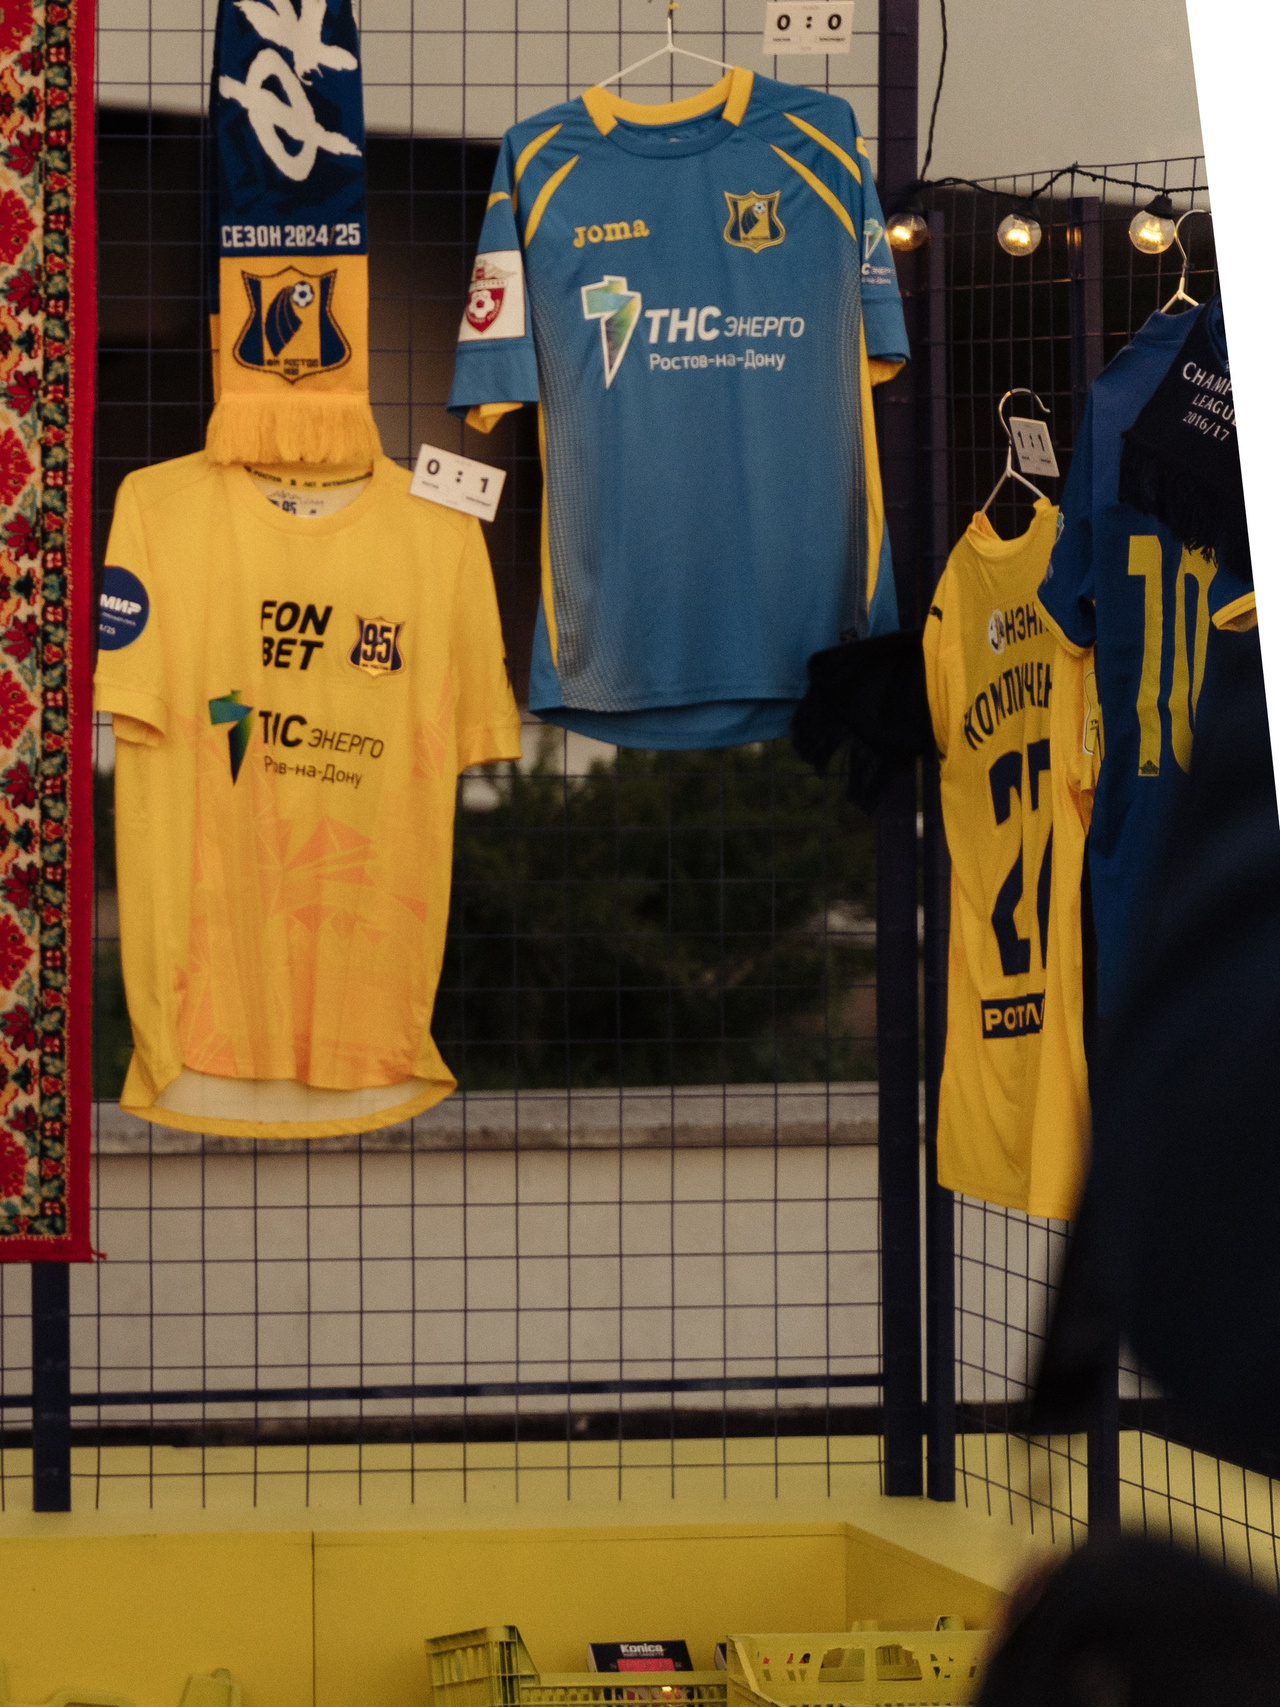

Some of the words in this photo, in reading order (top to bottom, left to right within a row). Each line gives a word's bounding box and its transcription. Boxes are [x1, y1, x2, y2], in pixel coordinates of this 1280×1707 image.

[777, 14, 791, 31] 0
[828, 14, 842, 31] 0
[222, 225, 282, 248] СЕЗОН
[645, 306, 722, 344] ТНС
[724, 316, 805, 338] ЭНЕРГО
[649, 349, 786, 372] Ростов-на-Дону
[1182, 411, 1230, 441] 2016/17
[426, 459, 440, 476] 0
[480, 476, 490, 494] 1
[261, 600, 333, 636] FON
